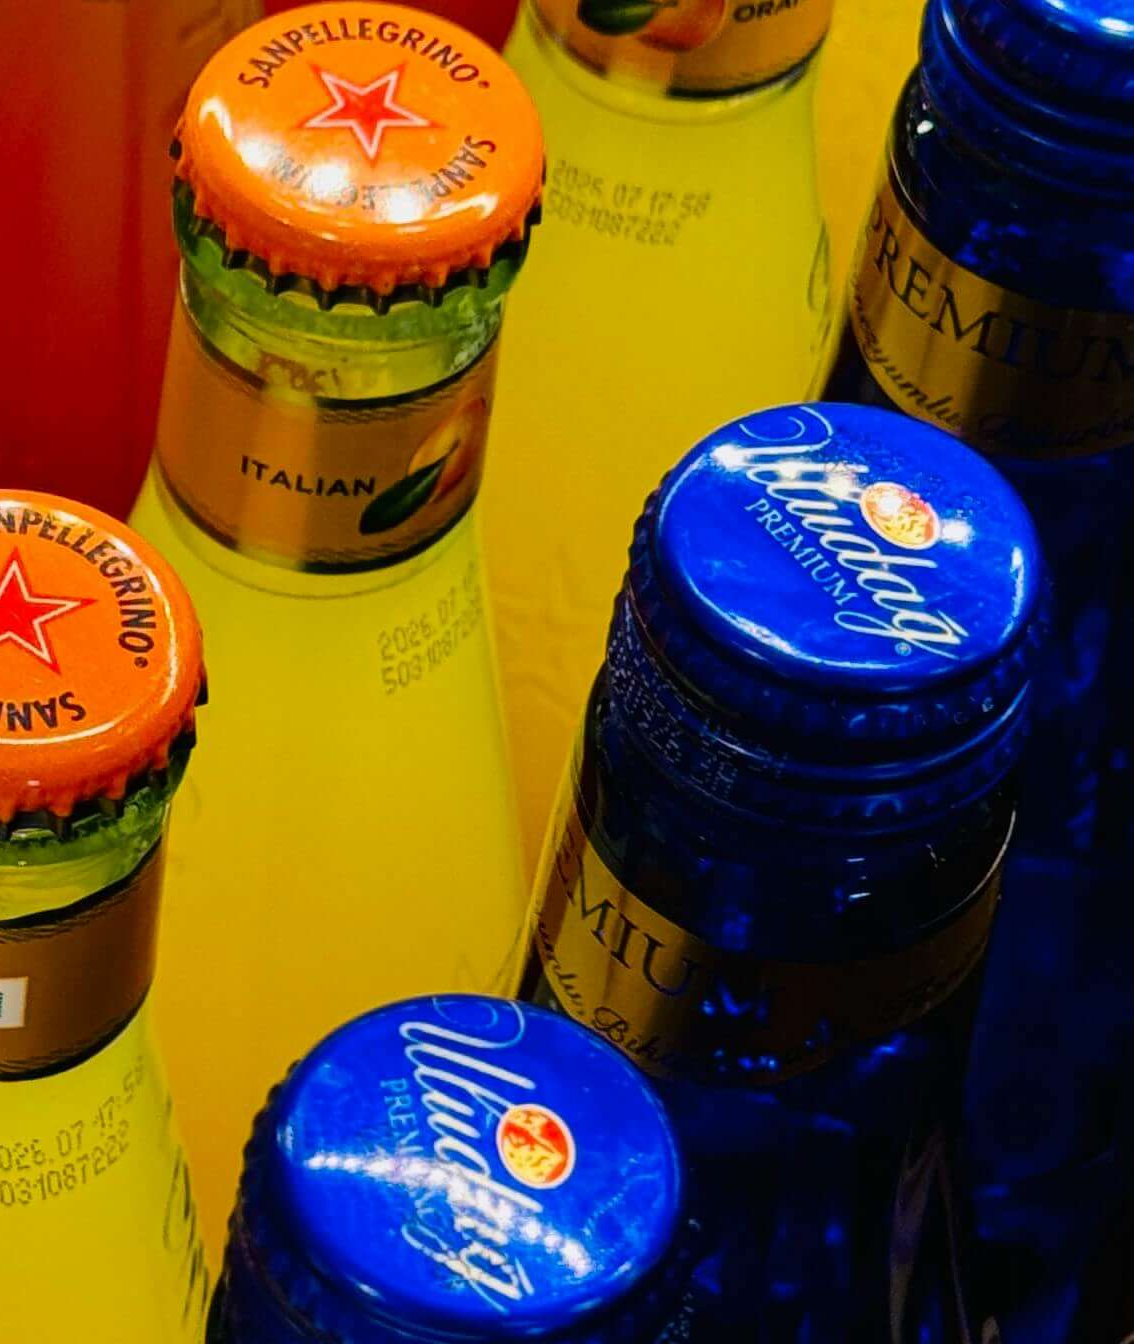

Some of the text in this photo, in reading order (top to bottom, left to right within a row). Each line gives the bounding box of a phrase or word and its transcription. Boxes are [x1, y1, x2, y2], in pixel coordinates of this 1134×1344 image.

[238, 17, 482, 89] SANPELLEGRINO
[238, 454, 377, 498] ITALIAN
[744, 496, 858, 607] PREMIUM
